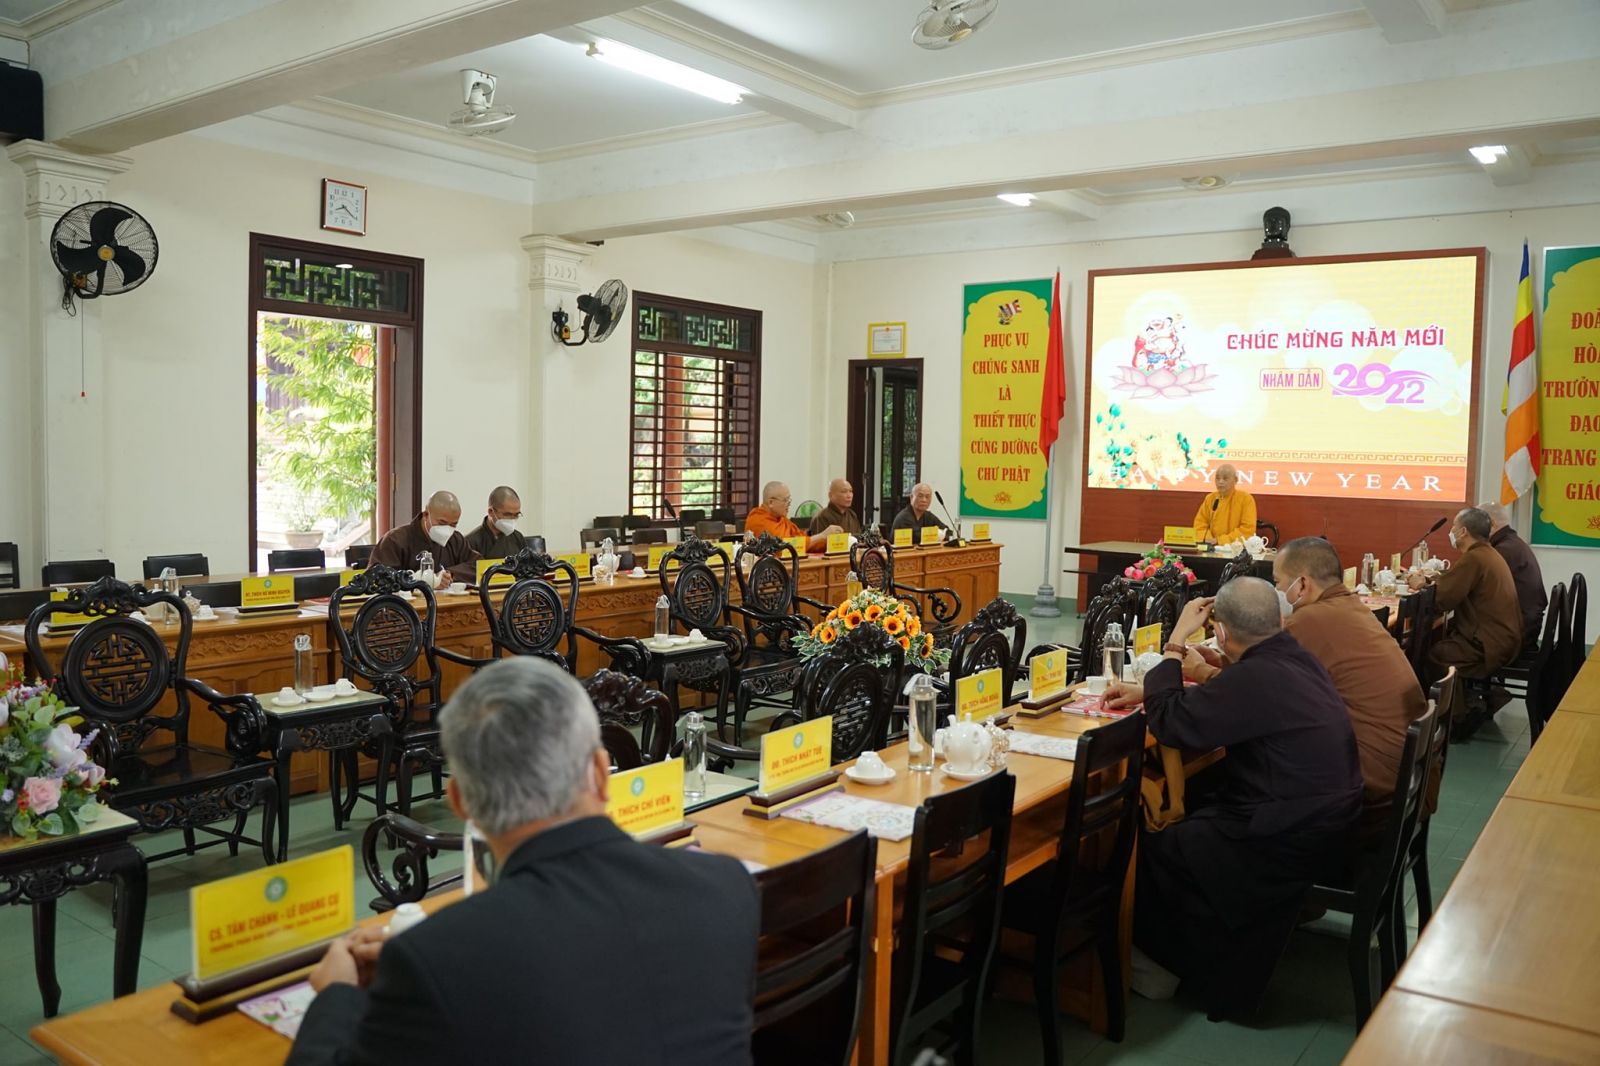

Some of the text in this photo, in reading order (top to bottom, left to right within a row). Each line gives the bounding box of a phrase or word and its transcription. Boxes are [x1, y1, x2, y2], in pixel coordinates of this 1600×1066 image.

[984, 332, 1030, 350] PHỤC VỤ
[1227, 325, 1444, 350] CHÚC MỪNG NĂM MỚI
[1573, 342, 1600, 364] HÒ
[972, 358, 1040, 374] CHÚNG SANH
[1332, 362, 1425, 404] 2022
[998, 385, 1012, 401] LÀ
[973, 409, 1036, 429] THIẾT THỰC
[970, 437, 1038, 455] CÚNG DƯỜNG
[1542, 448, 1597, 467] TRANG
[977, 466, 1030, 485] CHƯ PHẬT
[1236, 470, 1313, 487] NEW
[1336, 473, 1441, 492] YEAR
